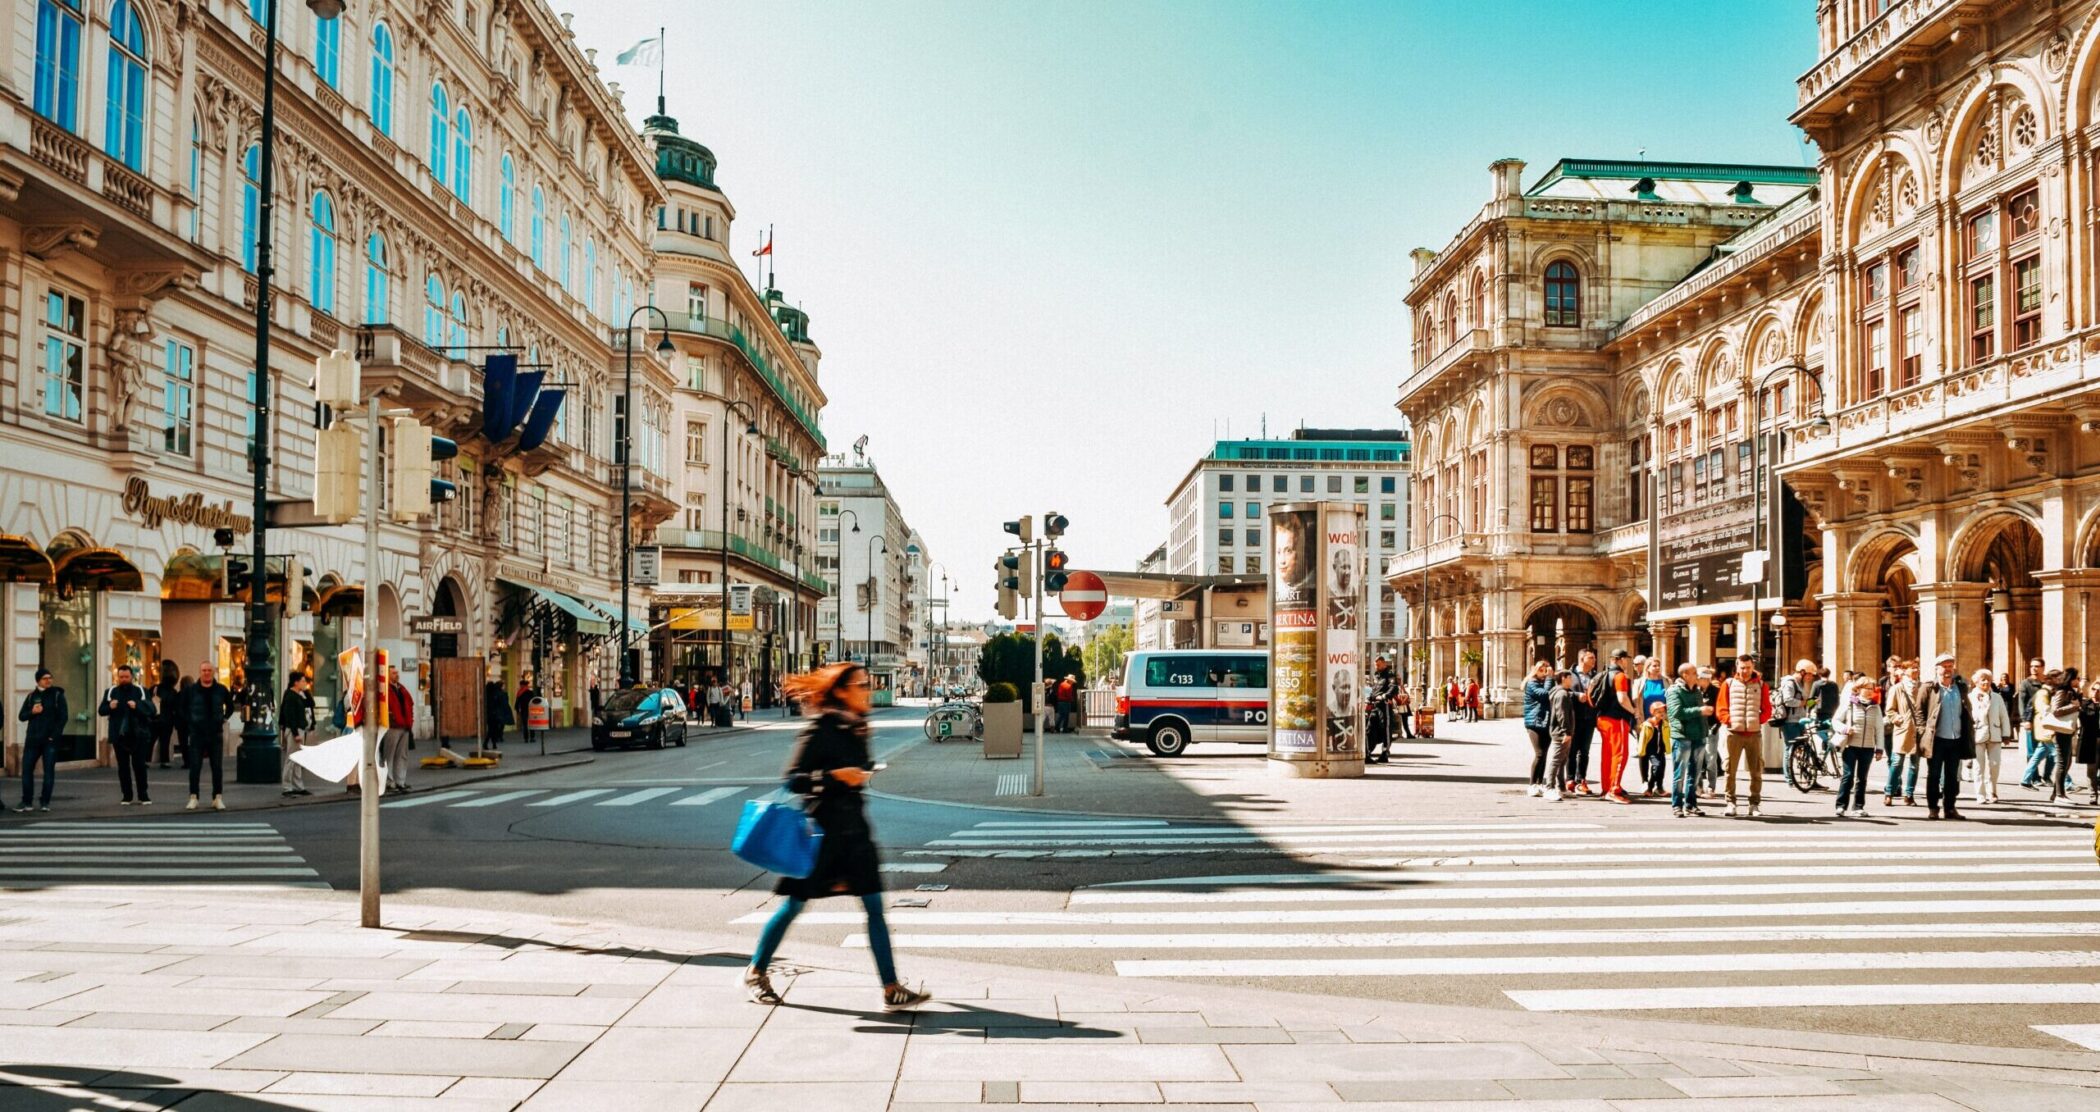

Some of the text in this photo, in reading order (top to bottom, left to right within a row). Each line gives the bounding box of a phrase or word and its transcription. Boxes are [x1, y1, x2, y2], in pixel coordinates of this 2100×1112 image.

[1276, 613, 1316, 625] ERTINA
[1177, 674, 1194, 685] 133
[1244, 710, 1267, 722] PO
[939, 723, 949, 735] P
[1276, 732, 1315, 745] ERTINA
